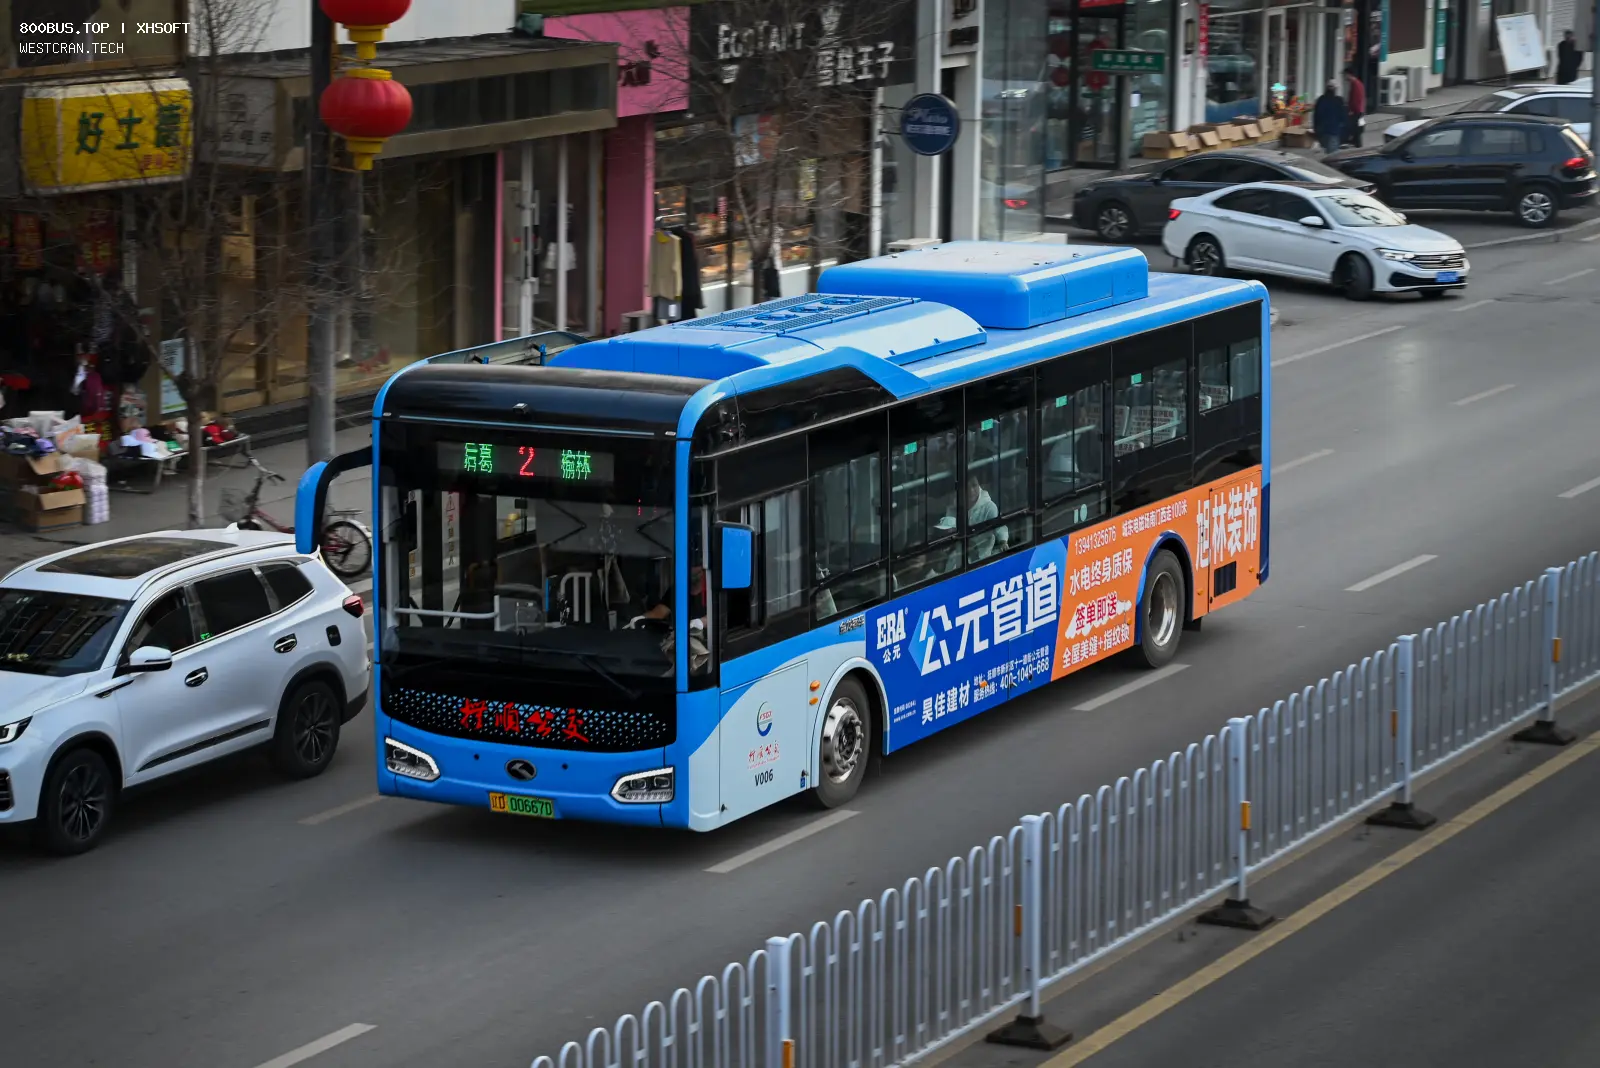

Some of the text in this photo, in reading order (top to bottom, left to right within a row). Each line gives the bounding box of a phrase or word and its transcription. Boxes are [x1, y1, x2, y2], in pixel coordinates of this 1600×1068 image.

[518, 445, 535, 477] 2
[1195, 481, 1259, 570] 旭林装饰
[1069, 547, 1133, 597] 水电终身质保
[876, 608, 906, 650] ERA
[919, 562, 1057, 676] 公元管道
[1075, 590, 1118, 632] 签单即送
[882, 643, 901, 664] 公元
[754, 768, 774, 787] V006
